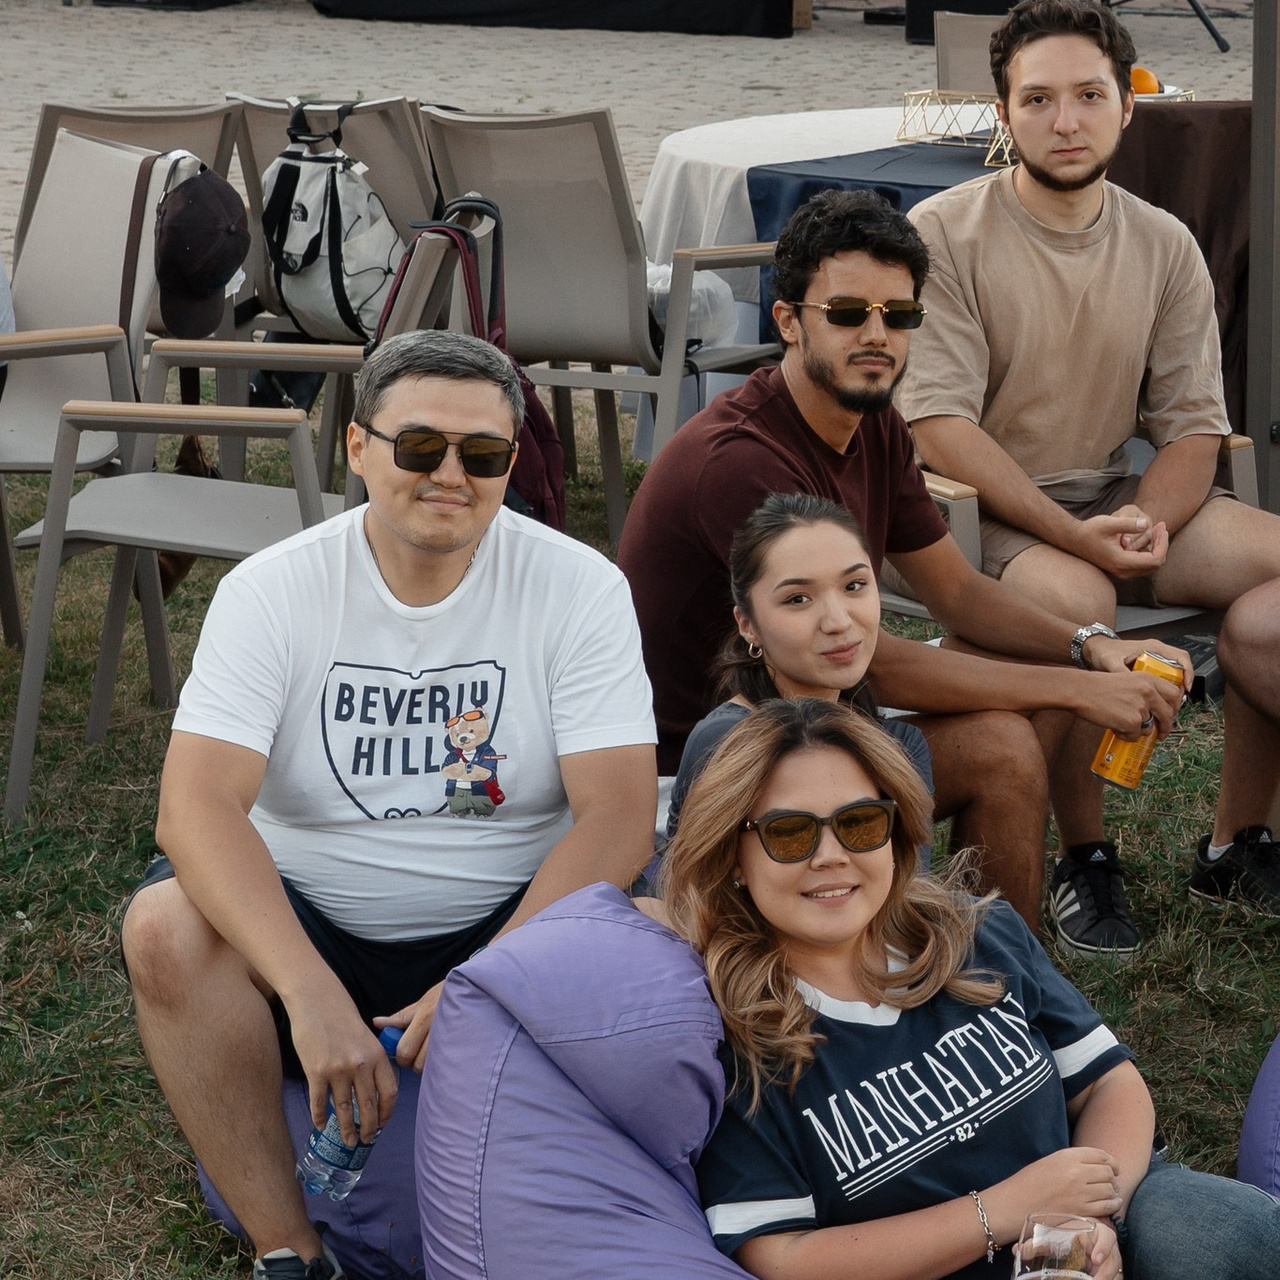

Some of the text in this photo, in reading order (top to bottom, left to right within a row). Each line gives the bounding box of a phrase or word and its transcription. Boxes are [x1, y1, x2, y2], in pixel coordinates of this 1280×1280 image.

[351, 734, 453, 776] HILL
[802, 992, 1042, 1181] MANHATTAN
[955, 1123, 975, 1142] 82
